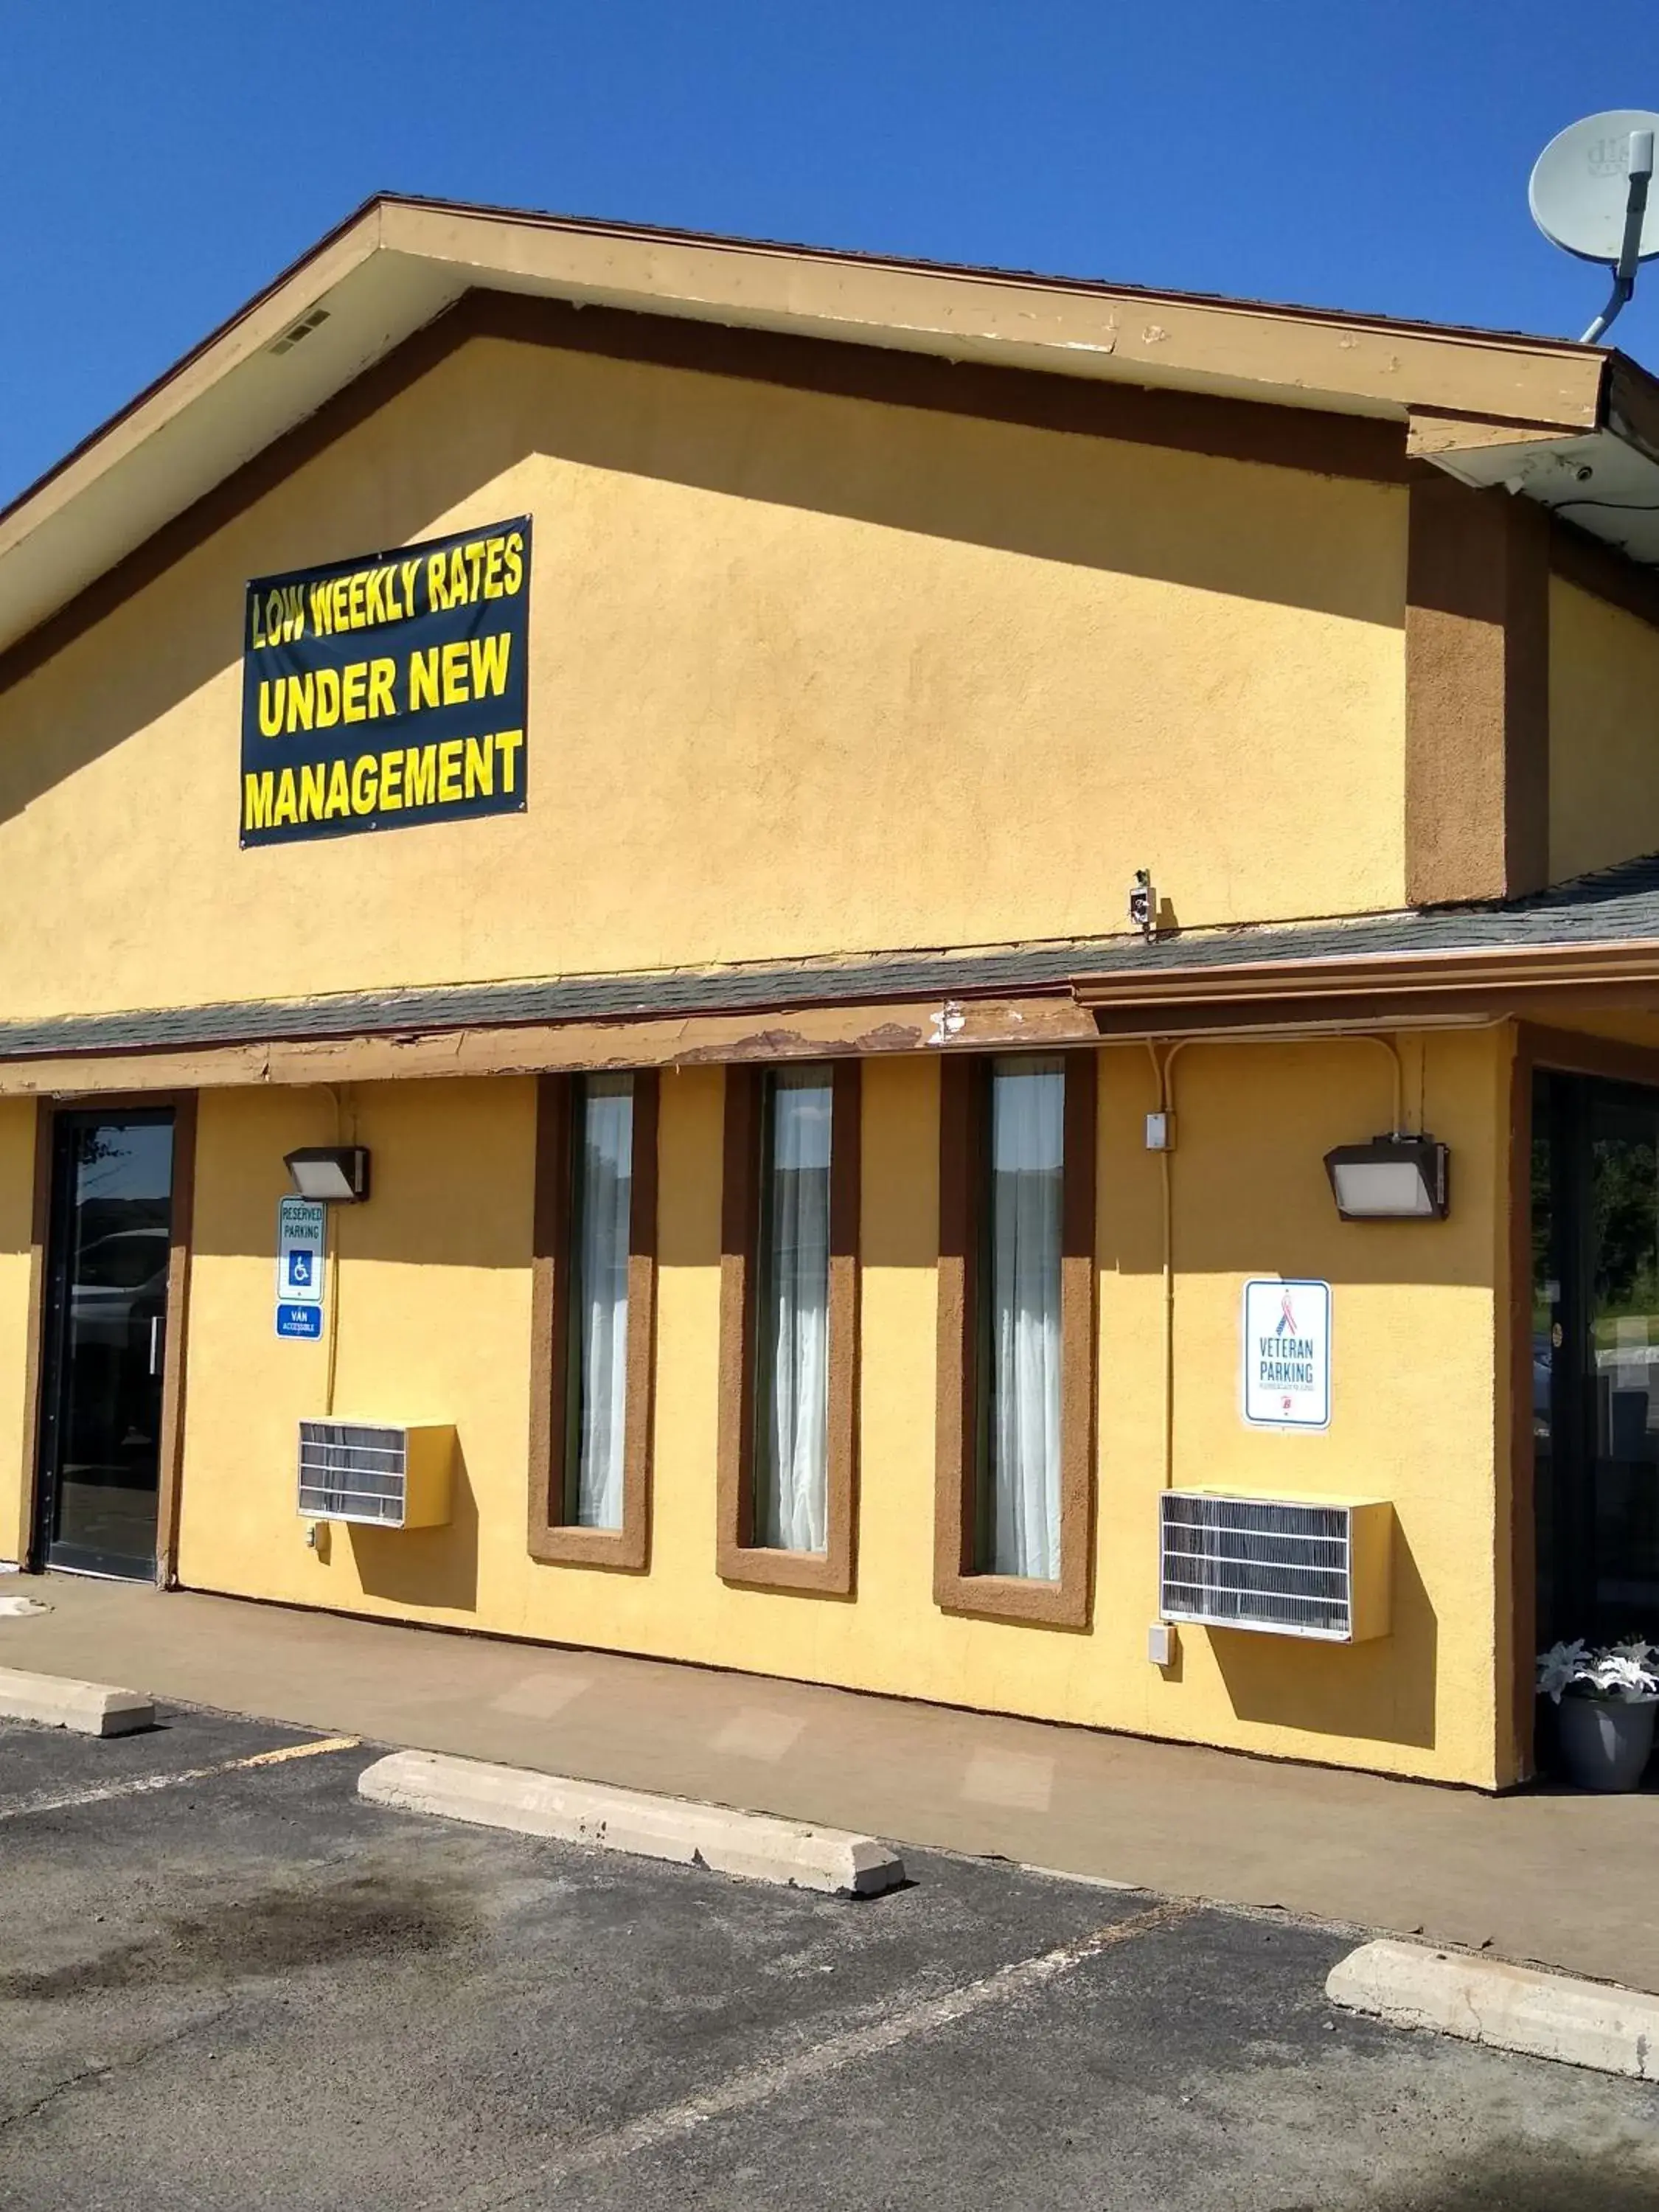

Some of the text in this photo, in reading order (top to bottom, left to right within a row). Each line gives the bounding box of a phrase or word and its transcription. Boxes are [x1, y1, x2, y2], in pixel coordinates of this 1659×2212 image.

[253, 532, 524, 650] LOW WEEKLY RATES
[259, 632, 512, 737] UNDER NEW
[245, 729, 524, 830] MANAGEMENT
[283, 1207, 322, 1220] RESERVED
[285, 1225, 319, 1239] PARKING
[291, 1310, 307, 1322] VAN
[1259, 1337, 1313, 1359] VETERAN
[1260, 1361, 1313, 1383] PARKING
